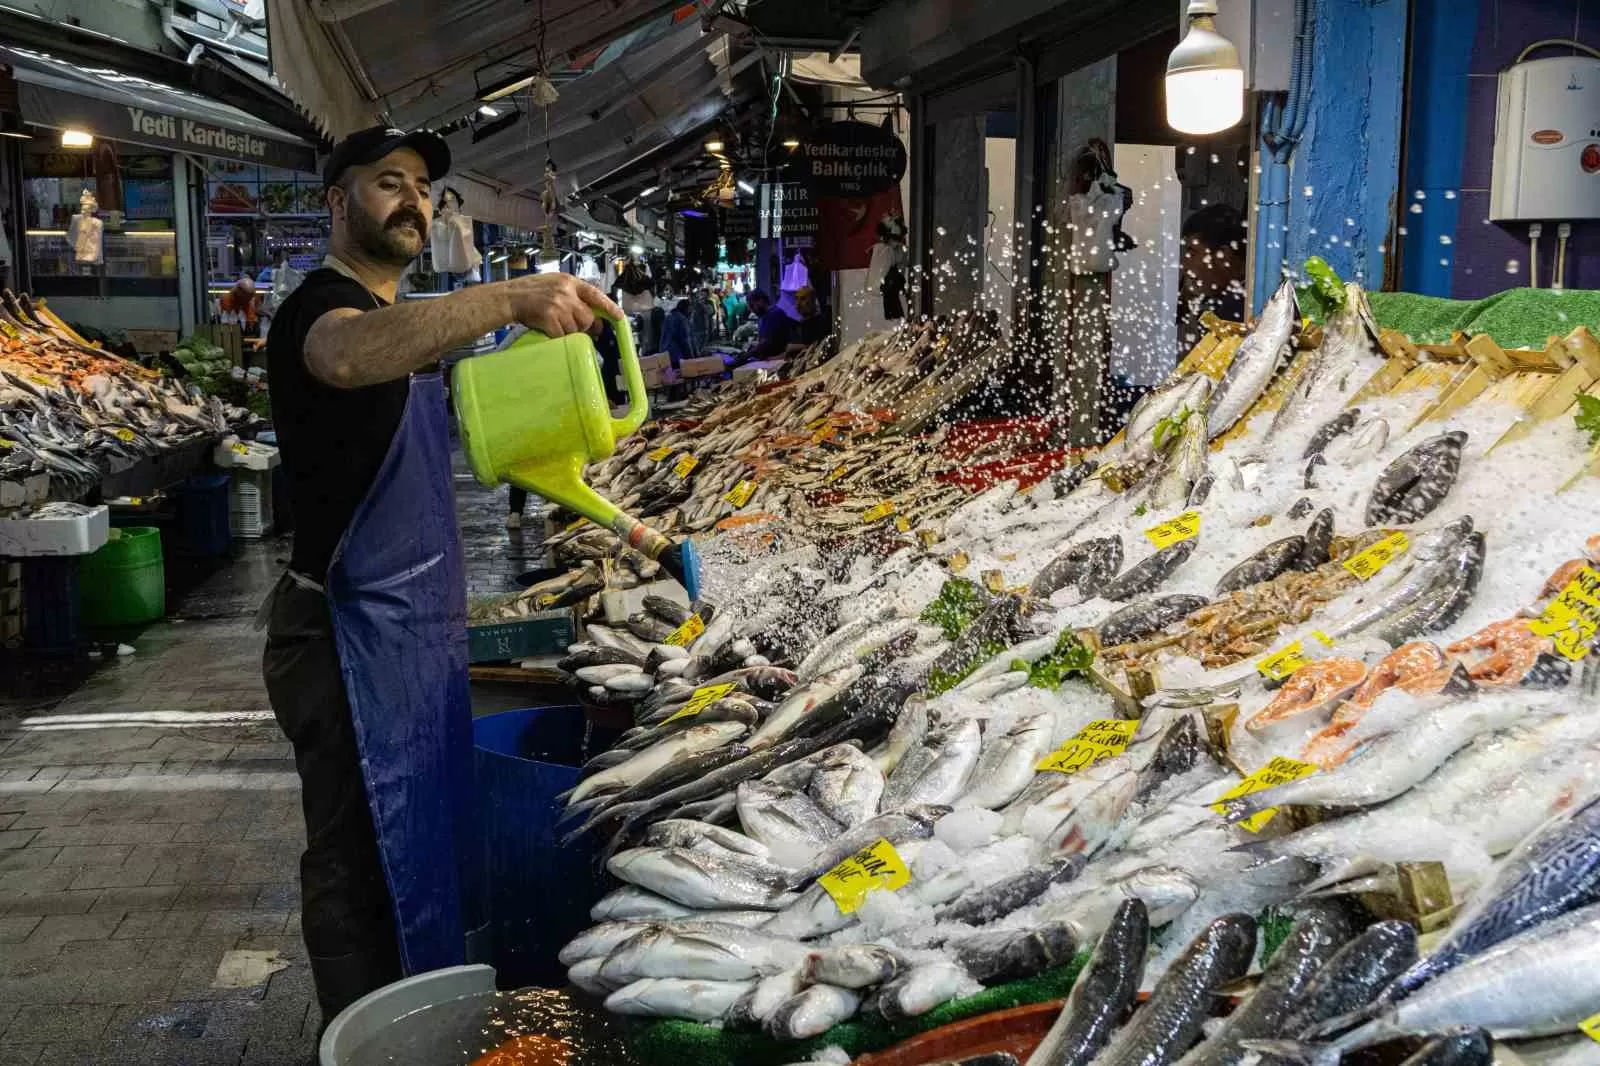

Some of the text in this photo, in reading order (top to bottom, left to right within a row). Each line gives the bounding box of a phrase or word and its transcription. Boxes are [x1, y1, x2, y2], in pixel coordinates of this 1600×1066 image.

[127, 107, 267, 157] Yedi Kardeşler
[811, 159, 889, 180] Balıkçılık
